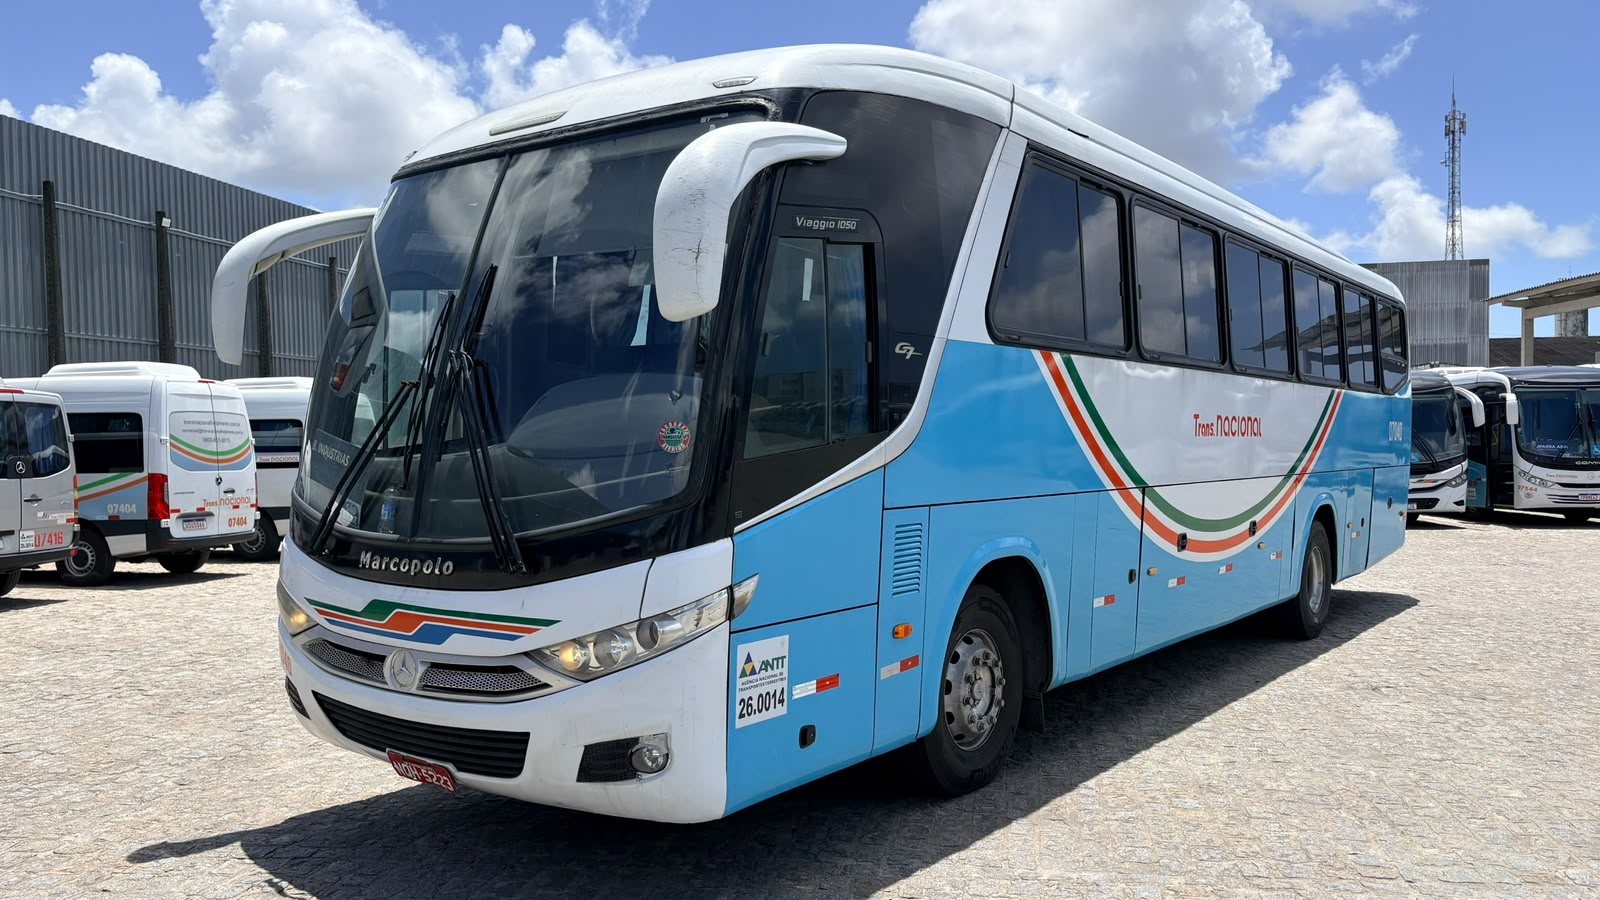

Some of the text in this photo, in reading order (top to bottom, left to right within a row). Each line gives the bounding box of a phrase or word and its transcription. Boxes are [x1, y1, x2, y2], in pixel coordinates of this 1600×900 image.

[796, 216, 857, 230] Viaggio 1050
[107, 503, 137, 514] 07404
[227, 516, 248, 528] 07404
[34, 530, 65, 548] 07416
[359, 550, 455, 576] Marcopolo
[757, 655, 787, 675] ANTT
[738, 687, 785, 720] 26.0014
